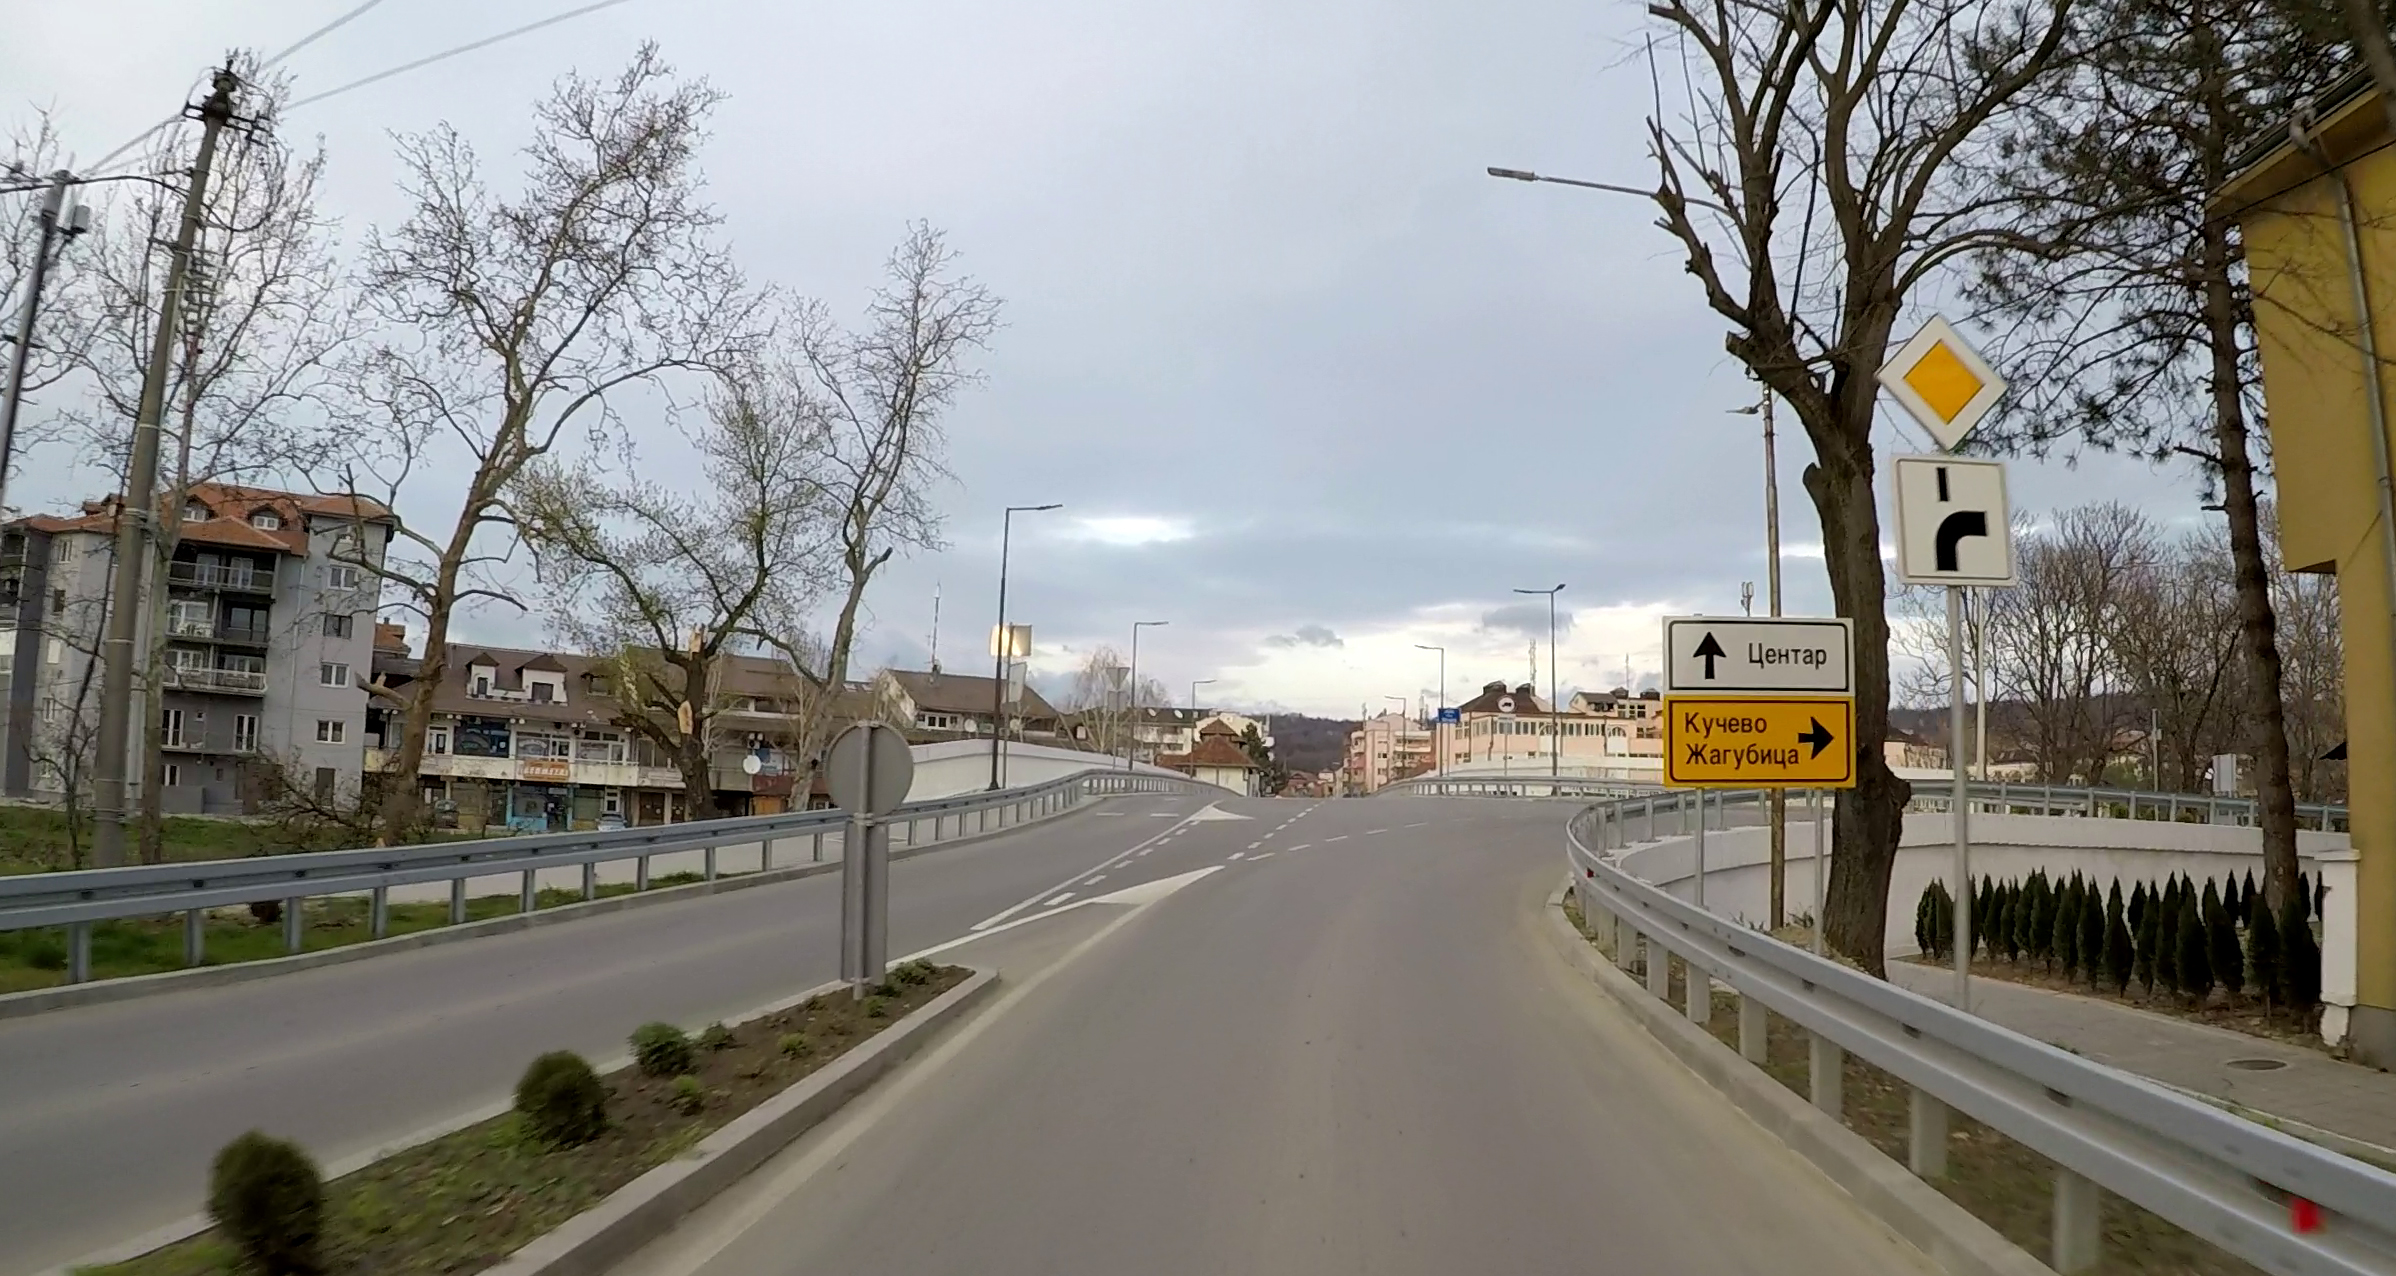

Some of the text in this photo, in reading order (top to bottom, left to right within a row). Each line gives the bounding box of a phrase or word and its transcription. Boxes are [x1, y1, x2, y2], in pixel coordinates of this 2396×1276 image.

[1748, 643, 1827, 670] Центар
[1684, 712, 1767, 739] Кучево
[1685, 743, 1799, 770] Жагубица
